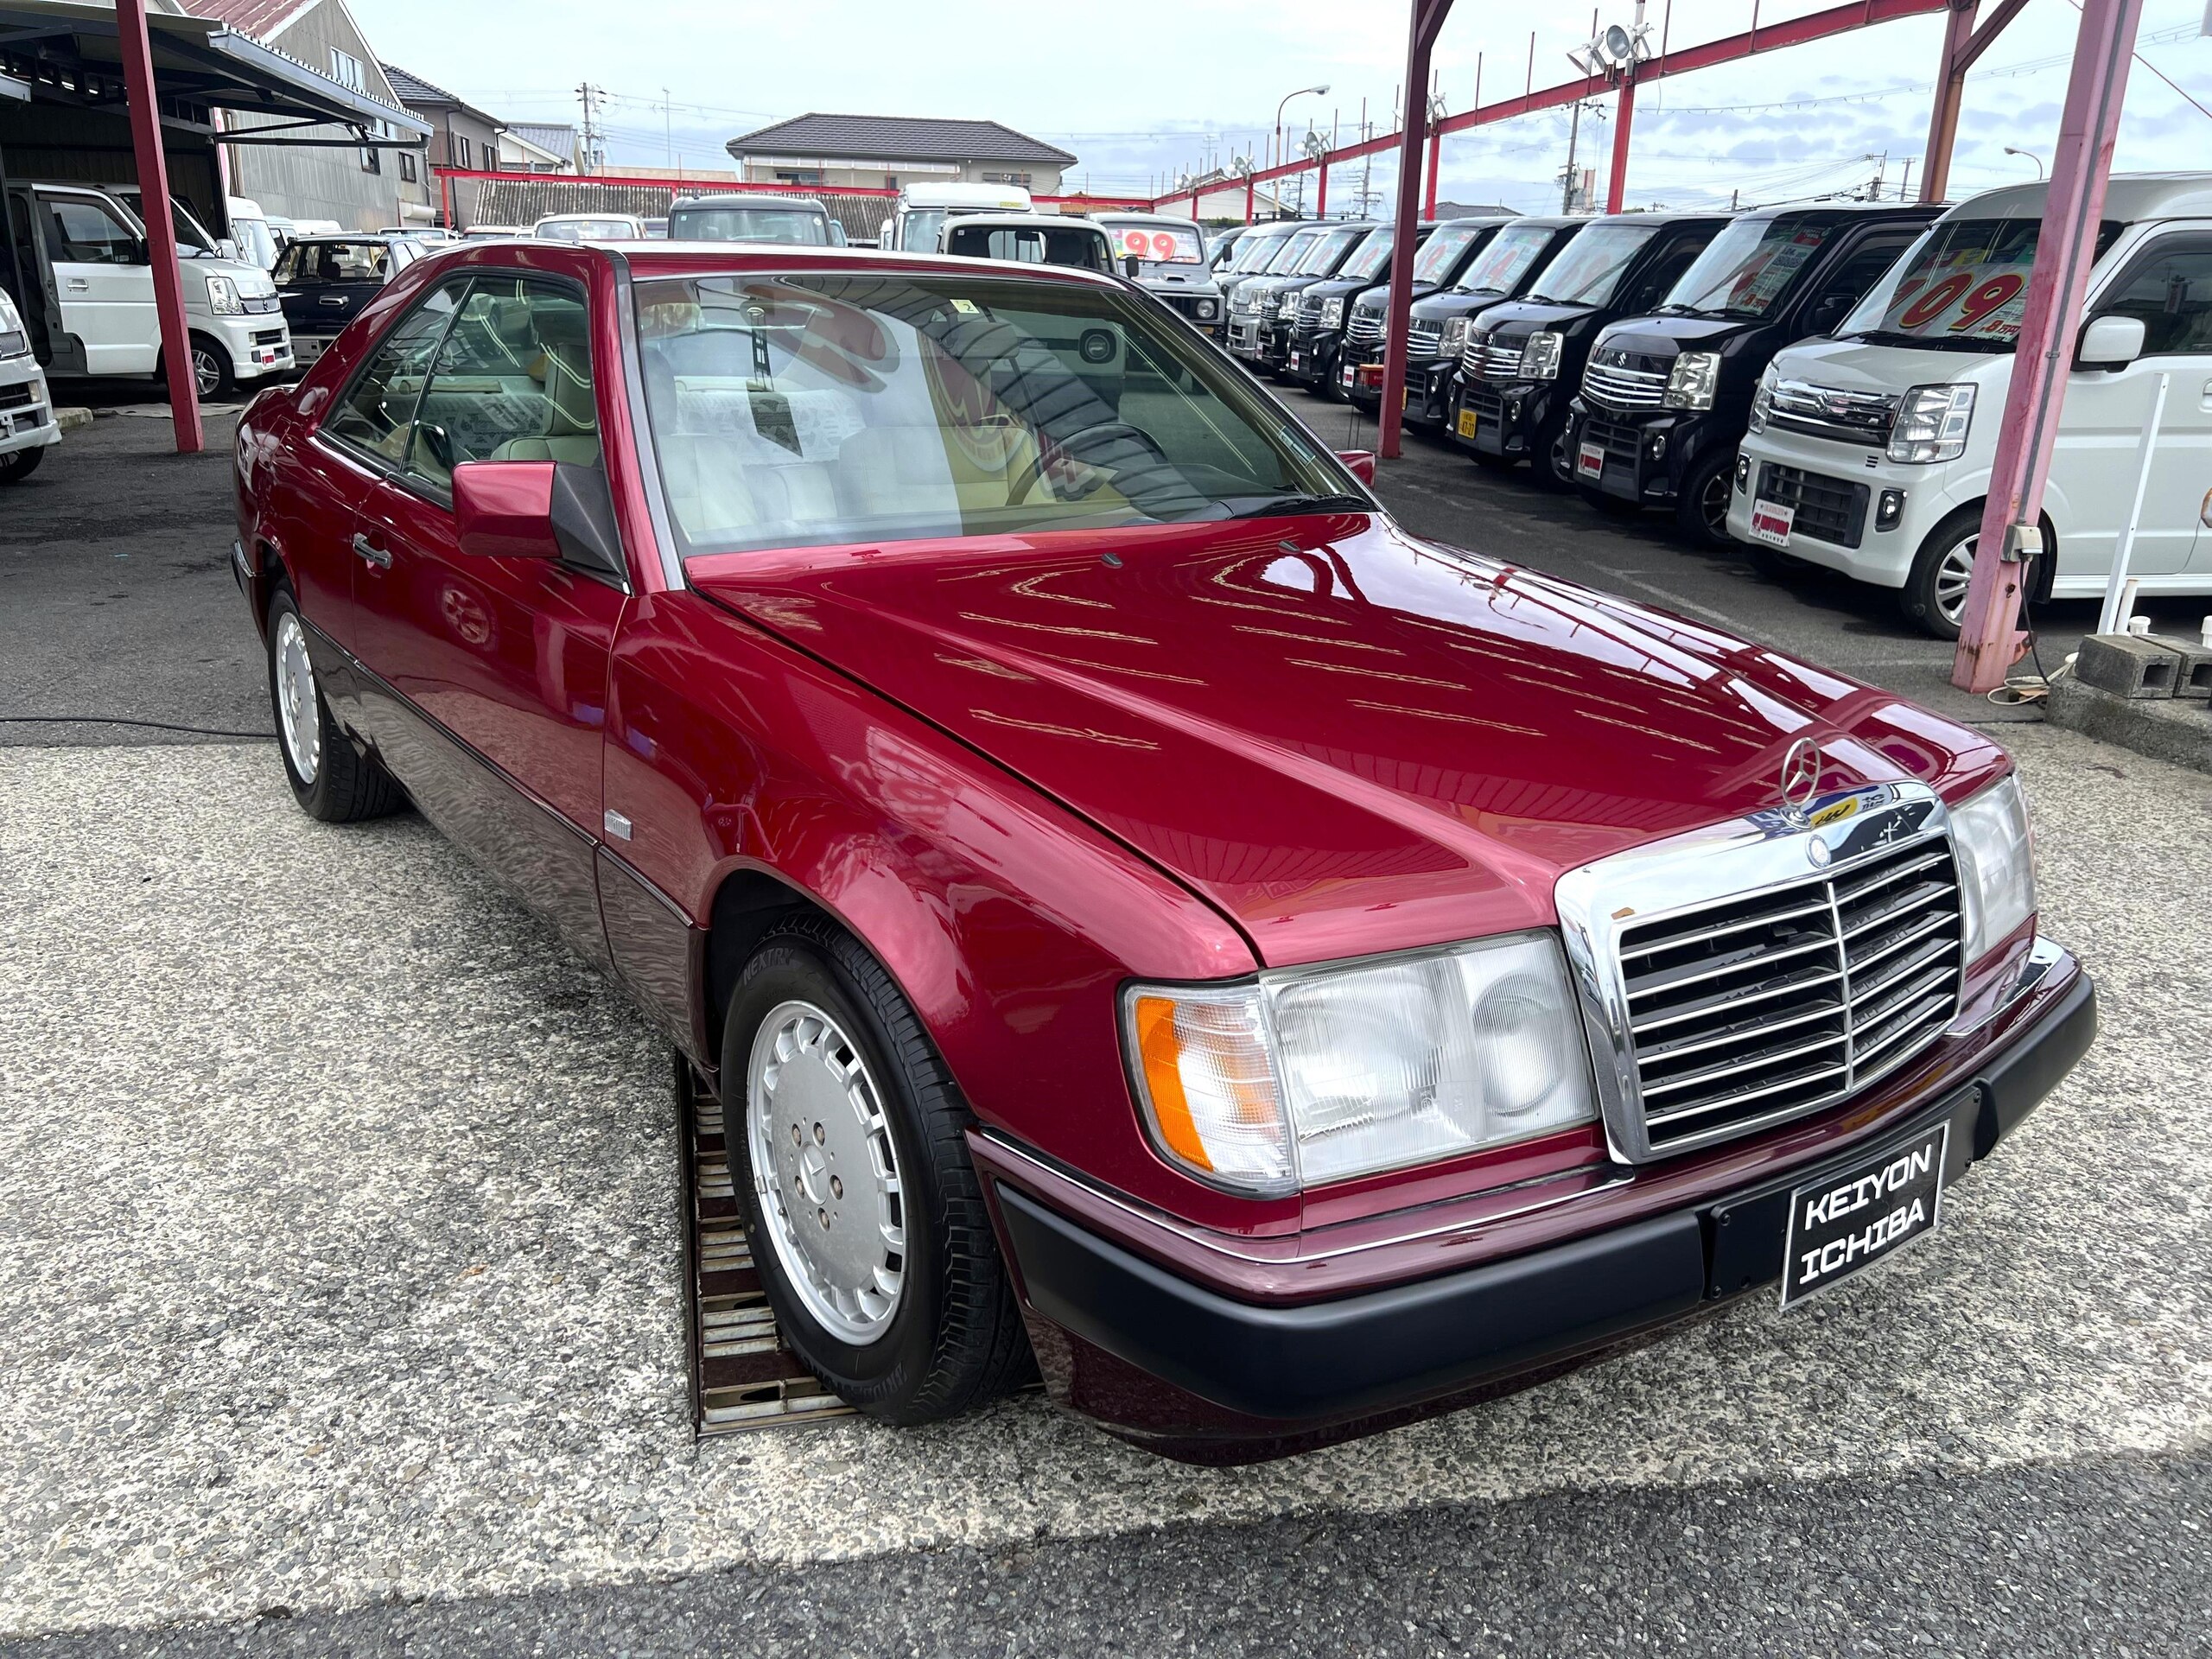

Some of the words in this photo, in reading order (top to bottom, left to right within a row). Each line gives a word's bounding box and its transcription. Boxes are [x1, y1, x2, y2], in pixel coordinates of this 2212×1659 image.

[1125, 231, 1176, 260] 99
[743, 947, 795, 987] NEXTRY
[1804, 1143, 1932, 1230] KEIYON
[1799, 1197, 1925, 1285] ICHIBA
